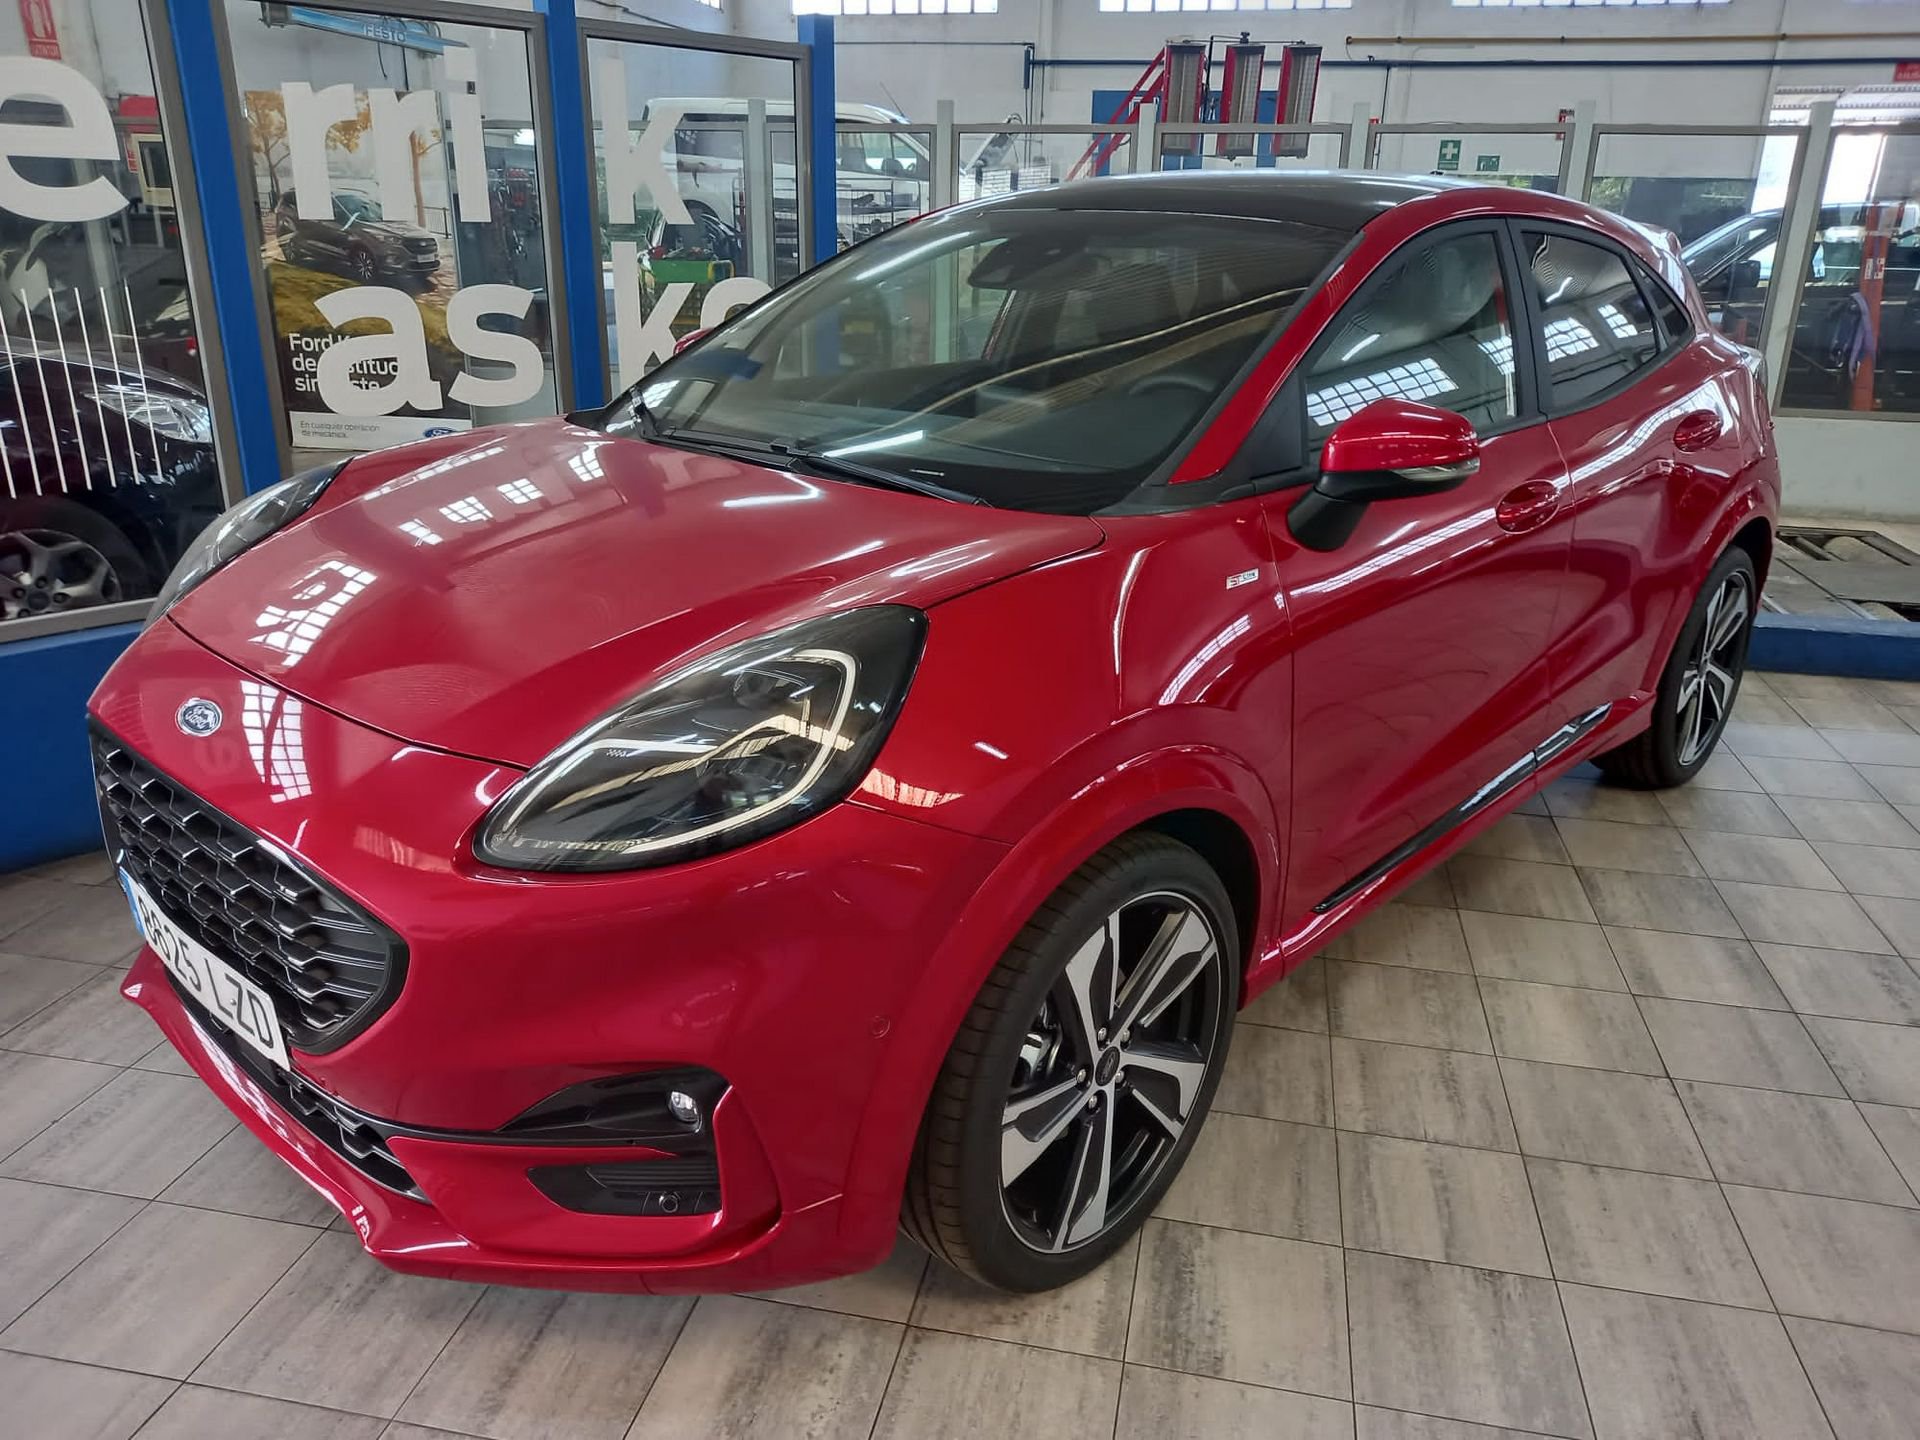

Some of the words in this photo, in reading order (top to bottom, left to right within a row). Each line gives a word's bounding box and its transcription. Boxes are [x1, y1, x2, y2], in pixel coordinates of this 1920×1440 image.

[363, 23, 406, 42] FESTO
[289, 333, 333, 352] Ford
[203, 957, 274, 1050] LZD
